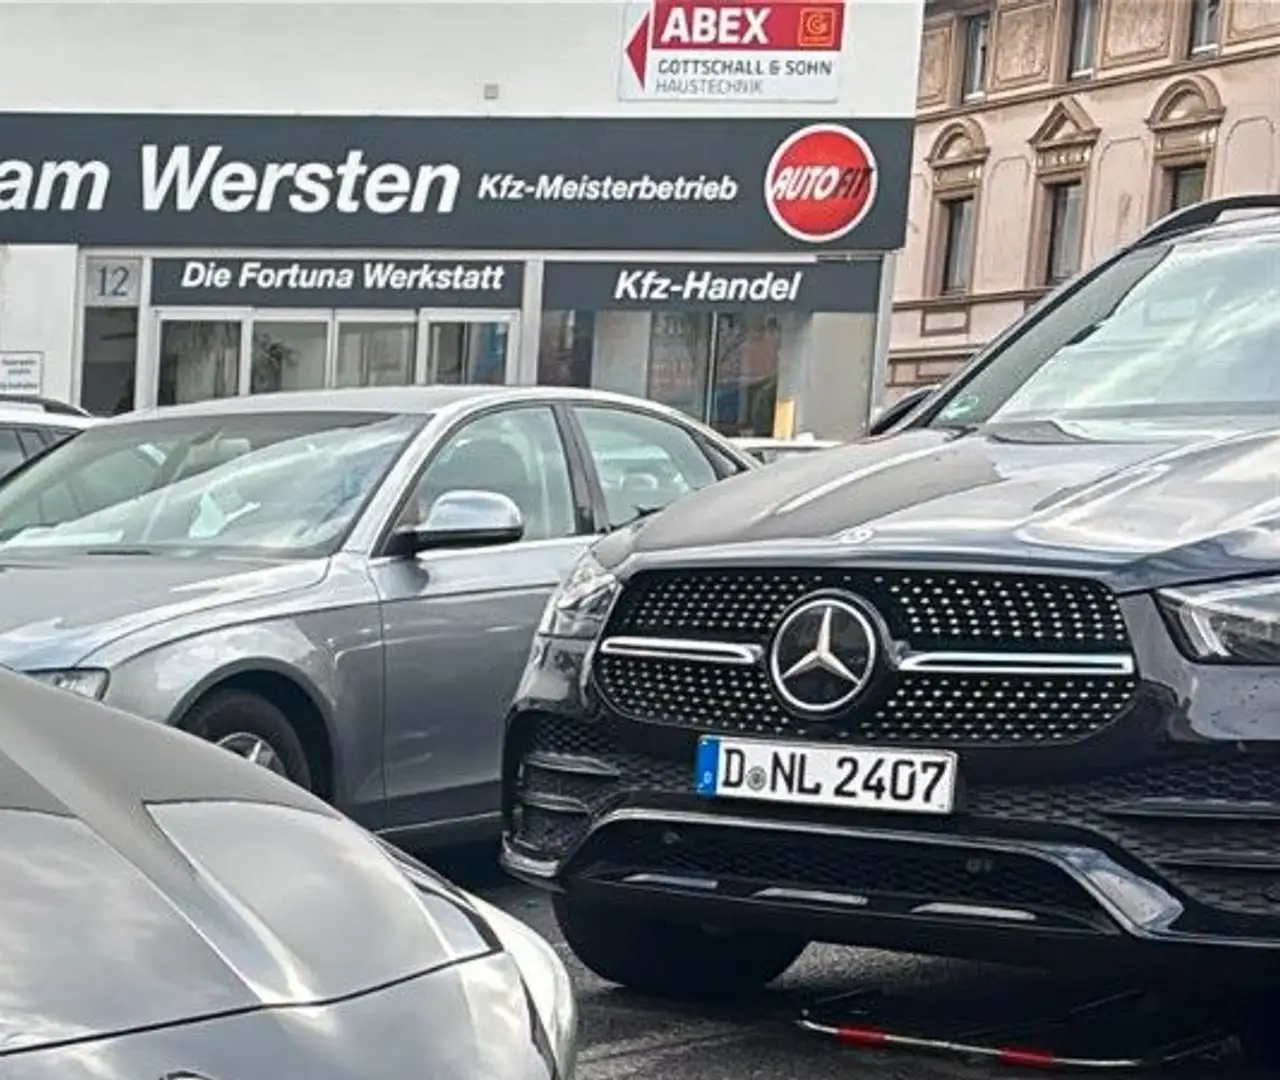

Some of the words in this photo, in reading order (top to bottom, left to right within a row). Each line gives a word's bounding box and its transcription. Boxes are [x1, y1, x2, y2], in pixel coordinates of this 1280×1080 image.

[659, 6, 773, 45] ABEX
[657, 58, 766, 76] GOTTSCHALL
[784, 59, 833, 76] SOHN
[655, 78, 764, 96] HAUSTECHNIK
[141, 143, 461, 214] Wersten
[477, 172, 740, 202] Kfz-Meisterbetrieb
[95, 265, 131, 297] 12
[180, 261, 232, 289] Die
[238, 261, 354, 290] Fortuna
[362, 262, 506, 291] Werkstatt
[614, 268, 804, 301] Kfz-Handel
[721, 748, 746, 789] D
[769, 751, 824, 796] NL
[832, 756, 949, 804] 2407
